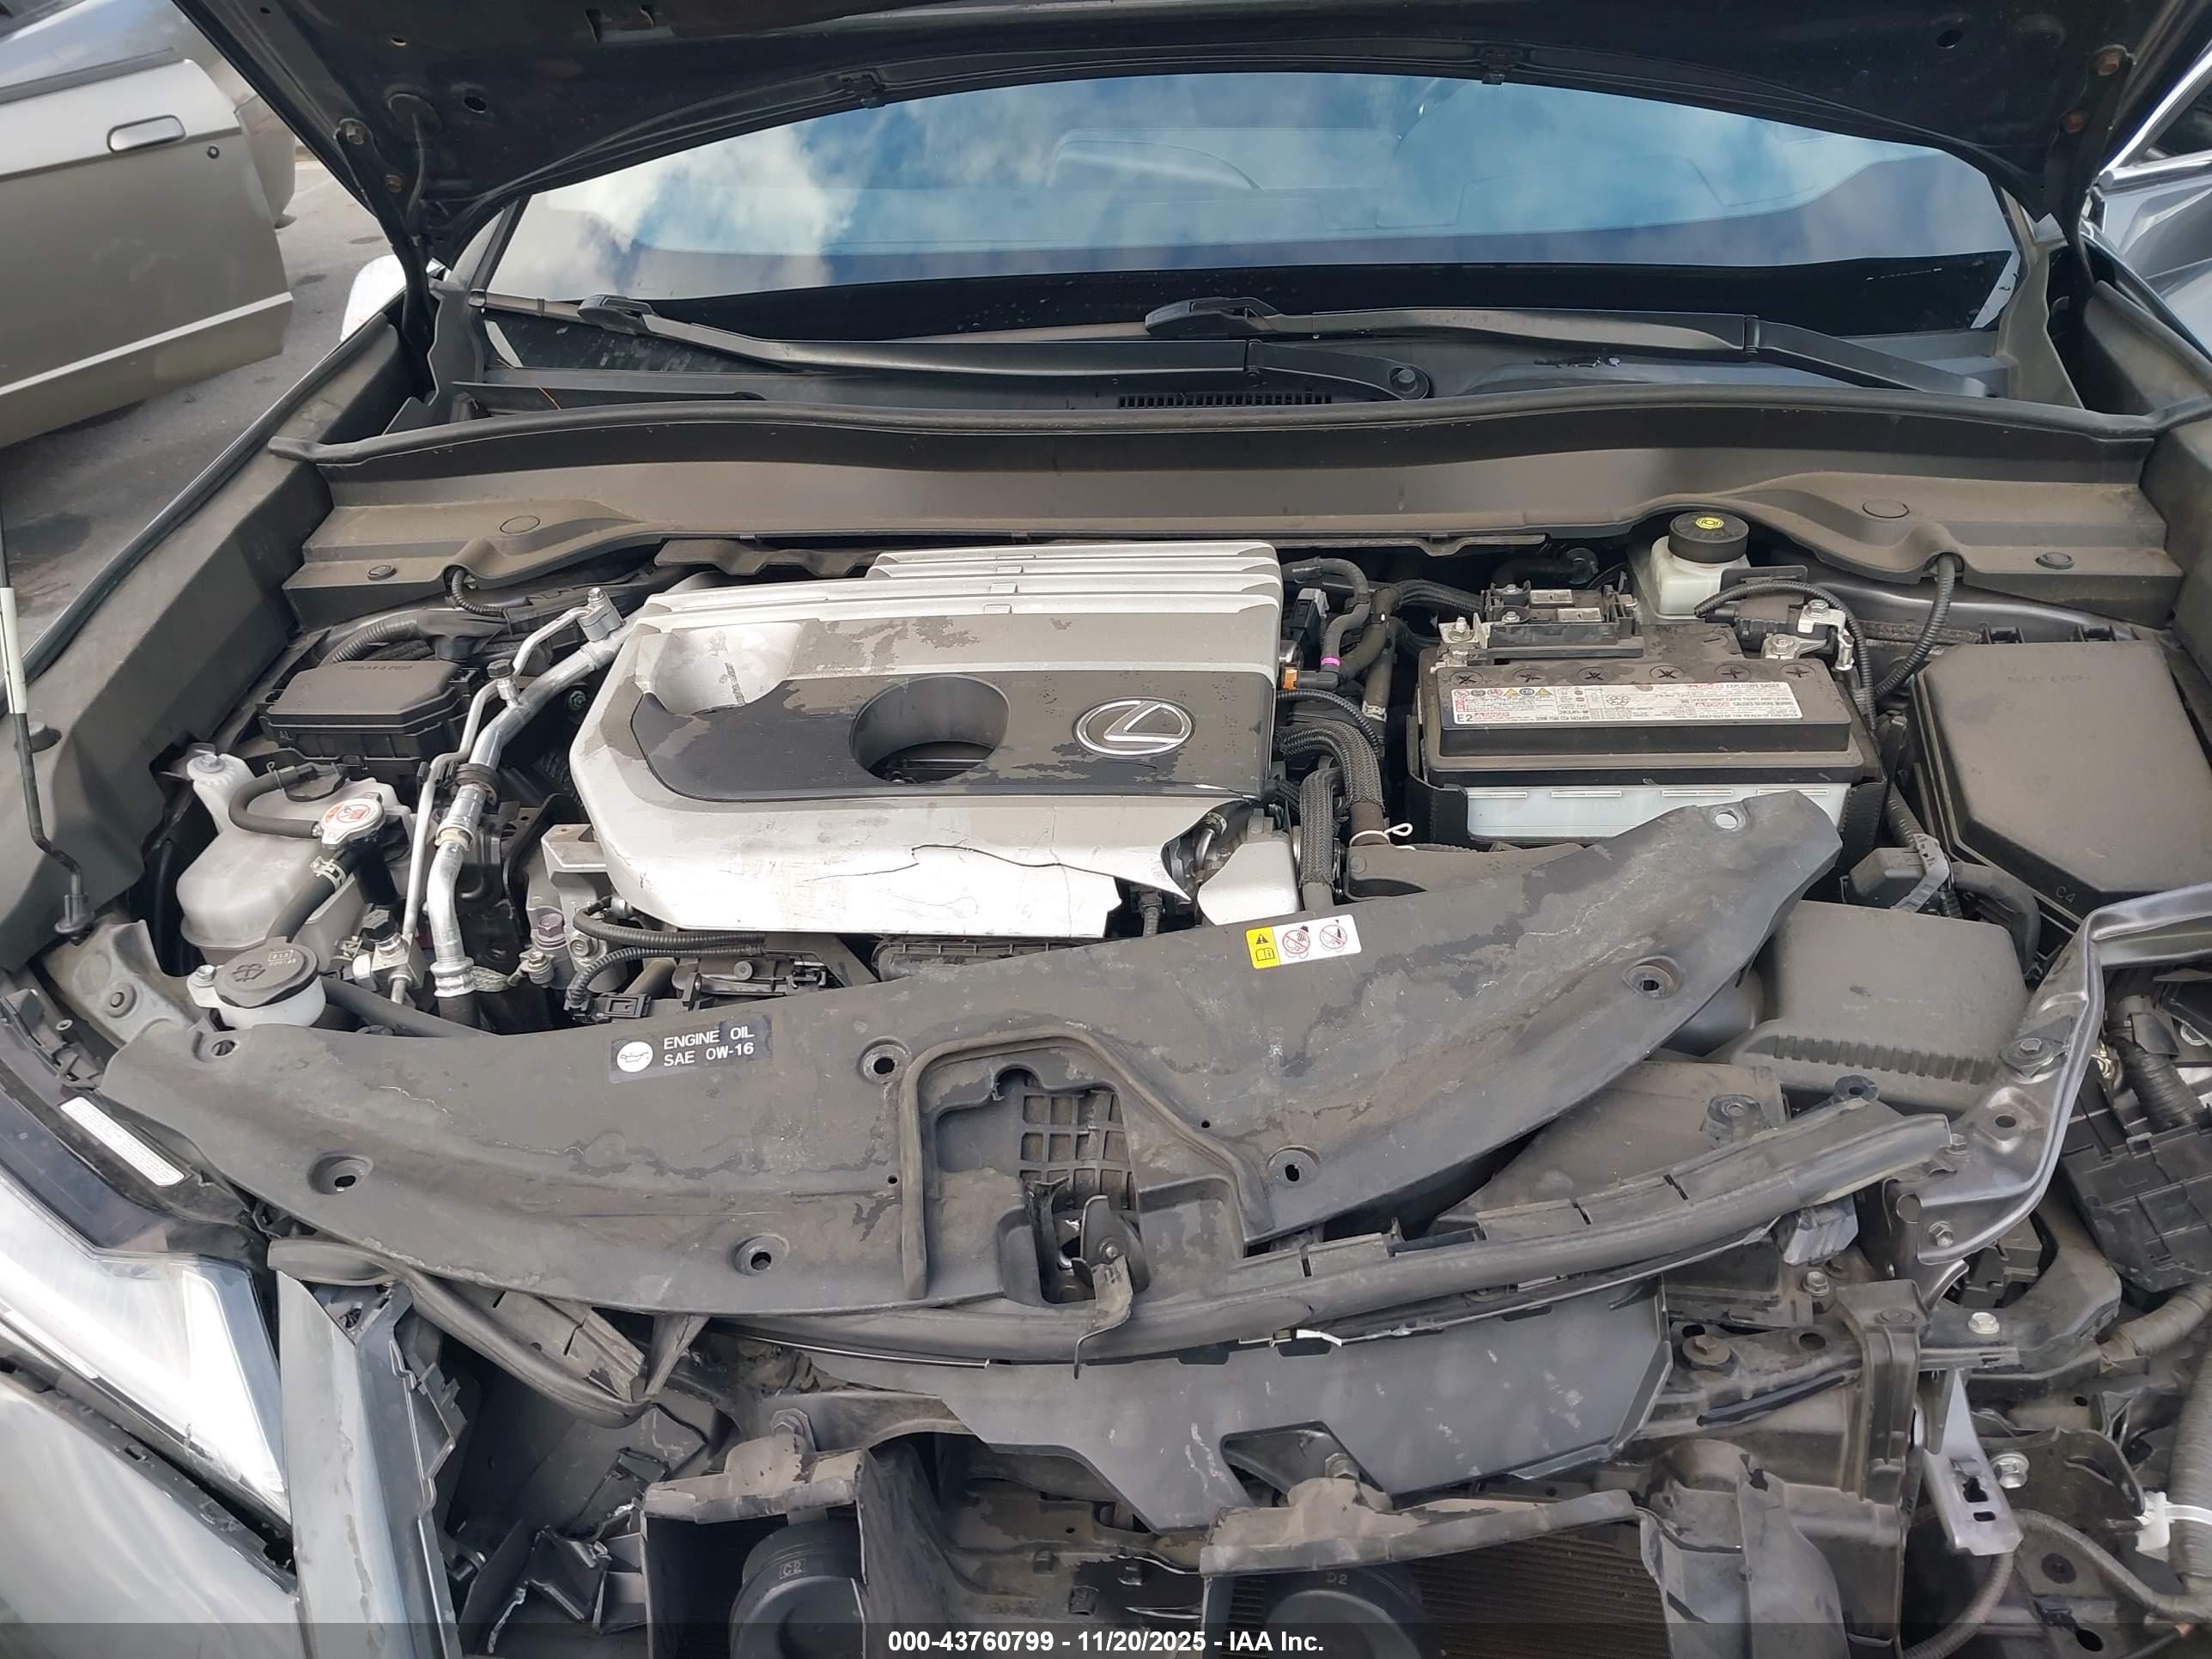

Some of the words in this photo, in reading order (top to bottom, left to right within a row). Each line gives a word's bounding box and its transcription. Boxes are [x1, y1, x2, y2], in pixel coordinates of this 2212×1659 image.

[1457, 714, 1474, 722] E2
[663, 1030, 720, 1051] ENGINE
[730, 1025, 755, 1041] OIL
[663, 1050, 696, 1067] SAE
[782, 1559, 805, 1577] C2
